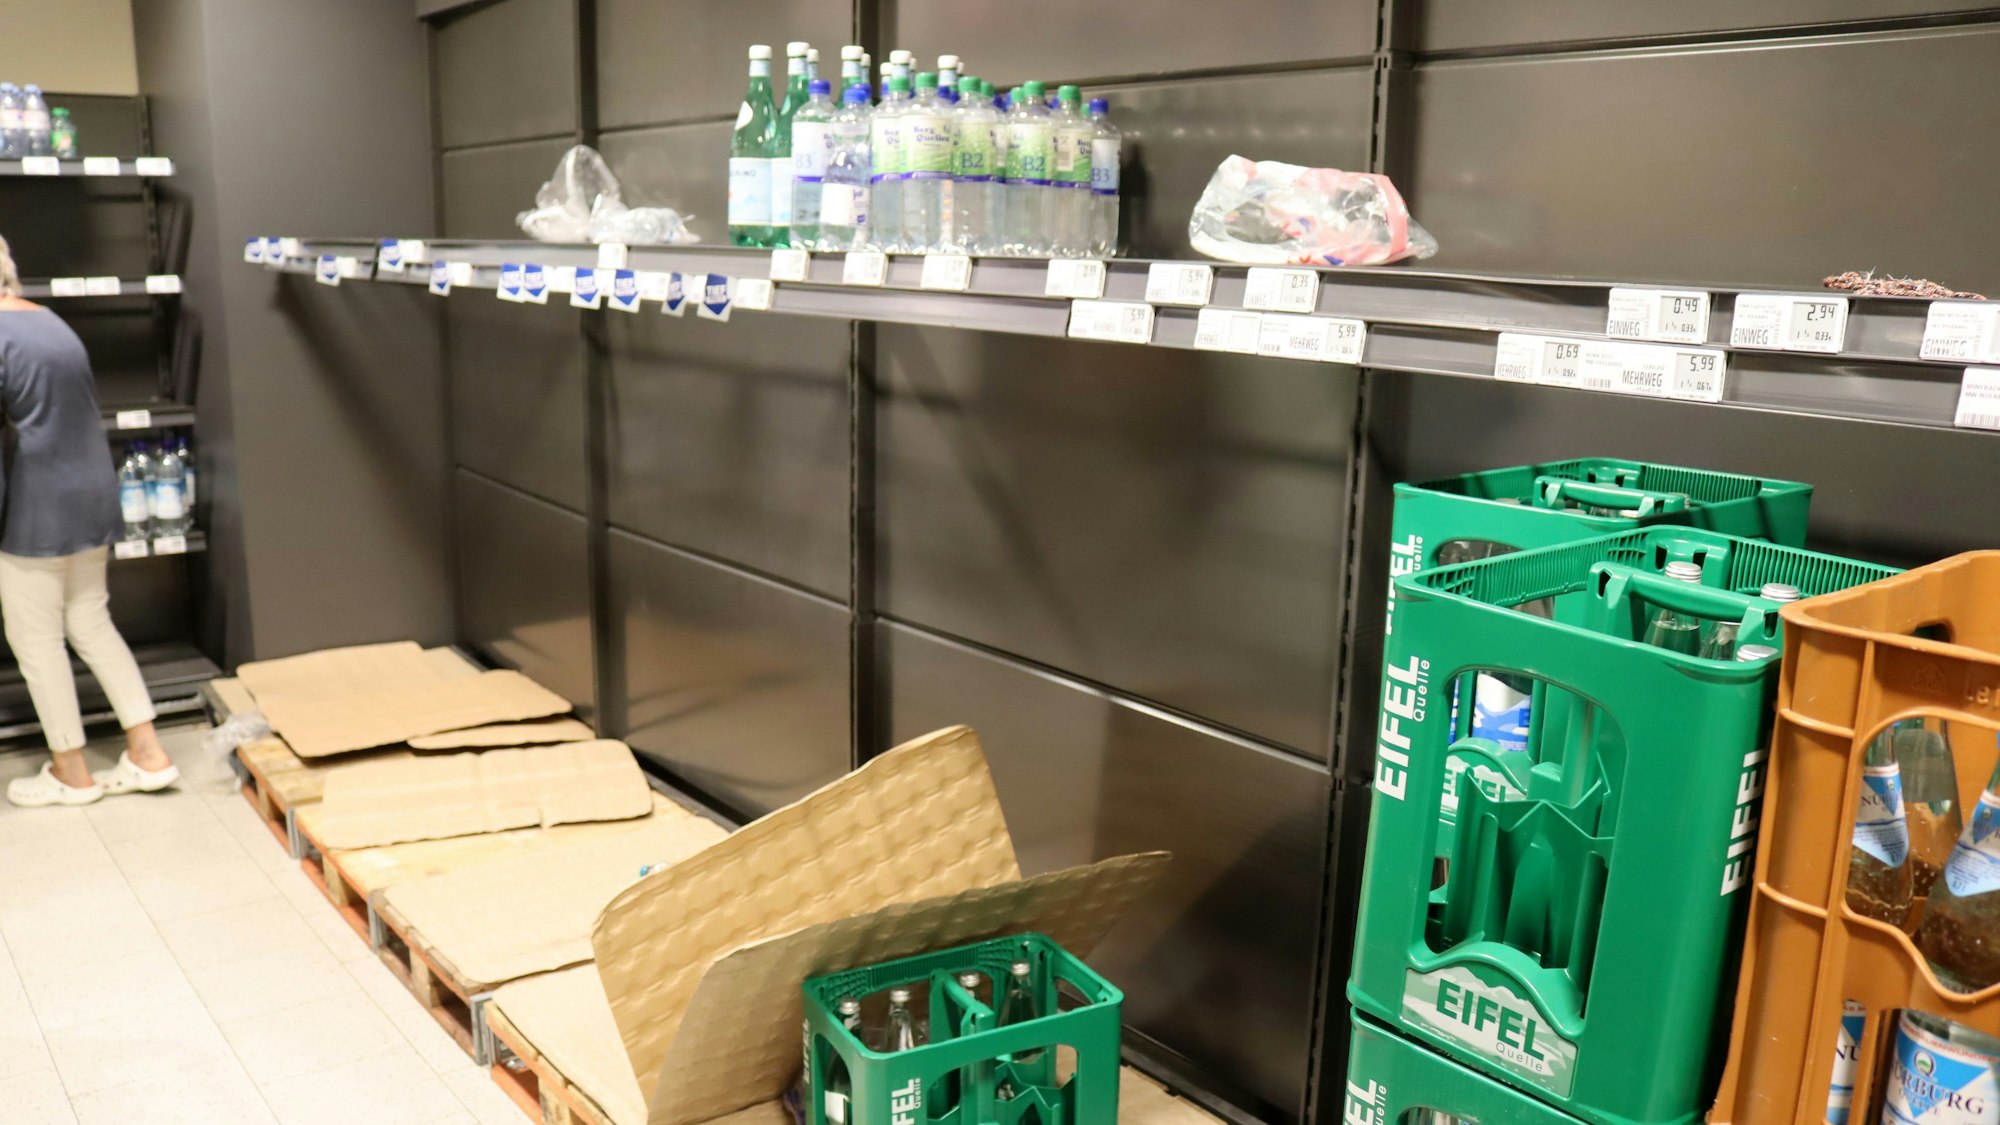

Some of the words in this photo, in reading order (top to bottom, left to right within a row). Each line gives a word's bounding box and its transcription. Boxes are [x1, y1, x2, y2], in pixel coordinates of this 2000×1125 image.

[961, 152, 984, 169] B2
[1024, 155, 1045, 172] B2
[1673, 297, 1698, 314] 0.49
[1807, 304, 1835, 321] 2.94
[1608, 320, 1640, 337] EINWEG
[1733, 327, 1769, 345] EINWEG
[1556, 344, 1579, 360] 0.69
[1497, 362, 1527, 380] MEHRWEG
[1689, 355, 1715, 372] 5.99
[1622, 369, 1663, 388] MEHRWEG
[1413, 659, 1431, 722] Quelle
[1375, 655, 1420, 801] EIFEL
[1436, 977, 1545, 1062] EIFEL
[1495, 1041, 1543, 1073] Quelle
[914, 1077, 922, 1110] Quelle
